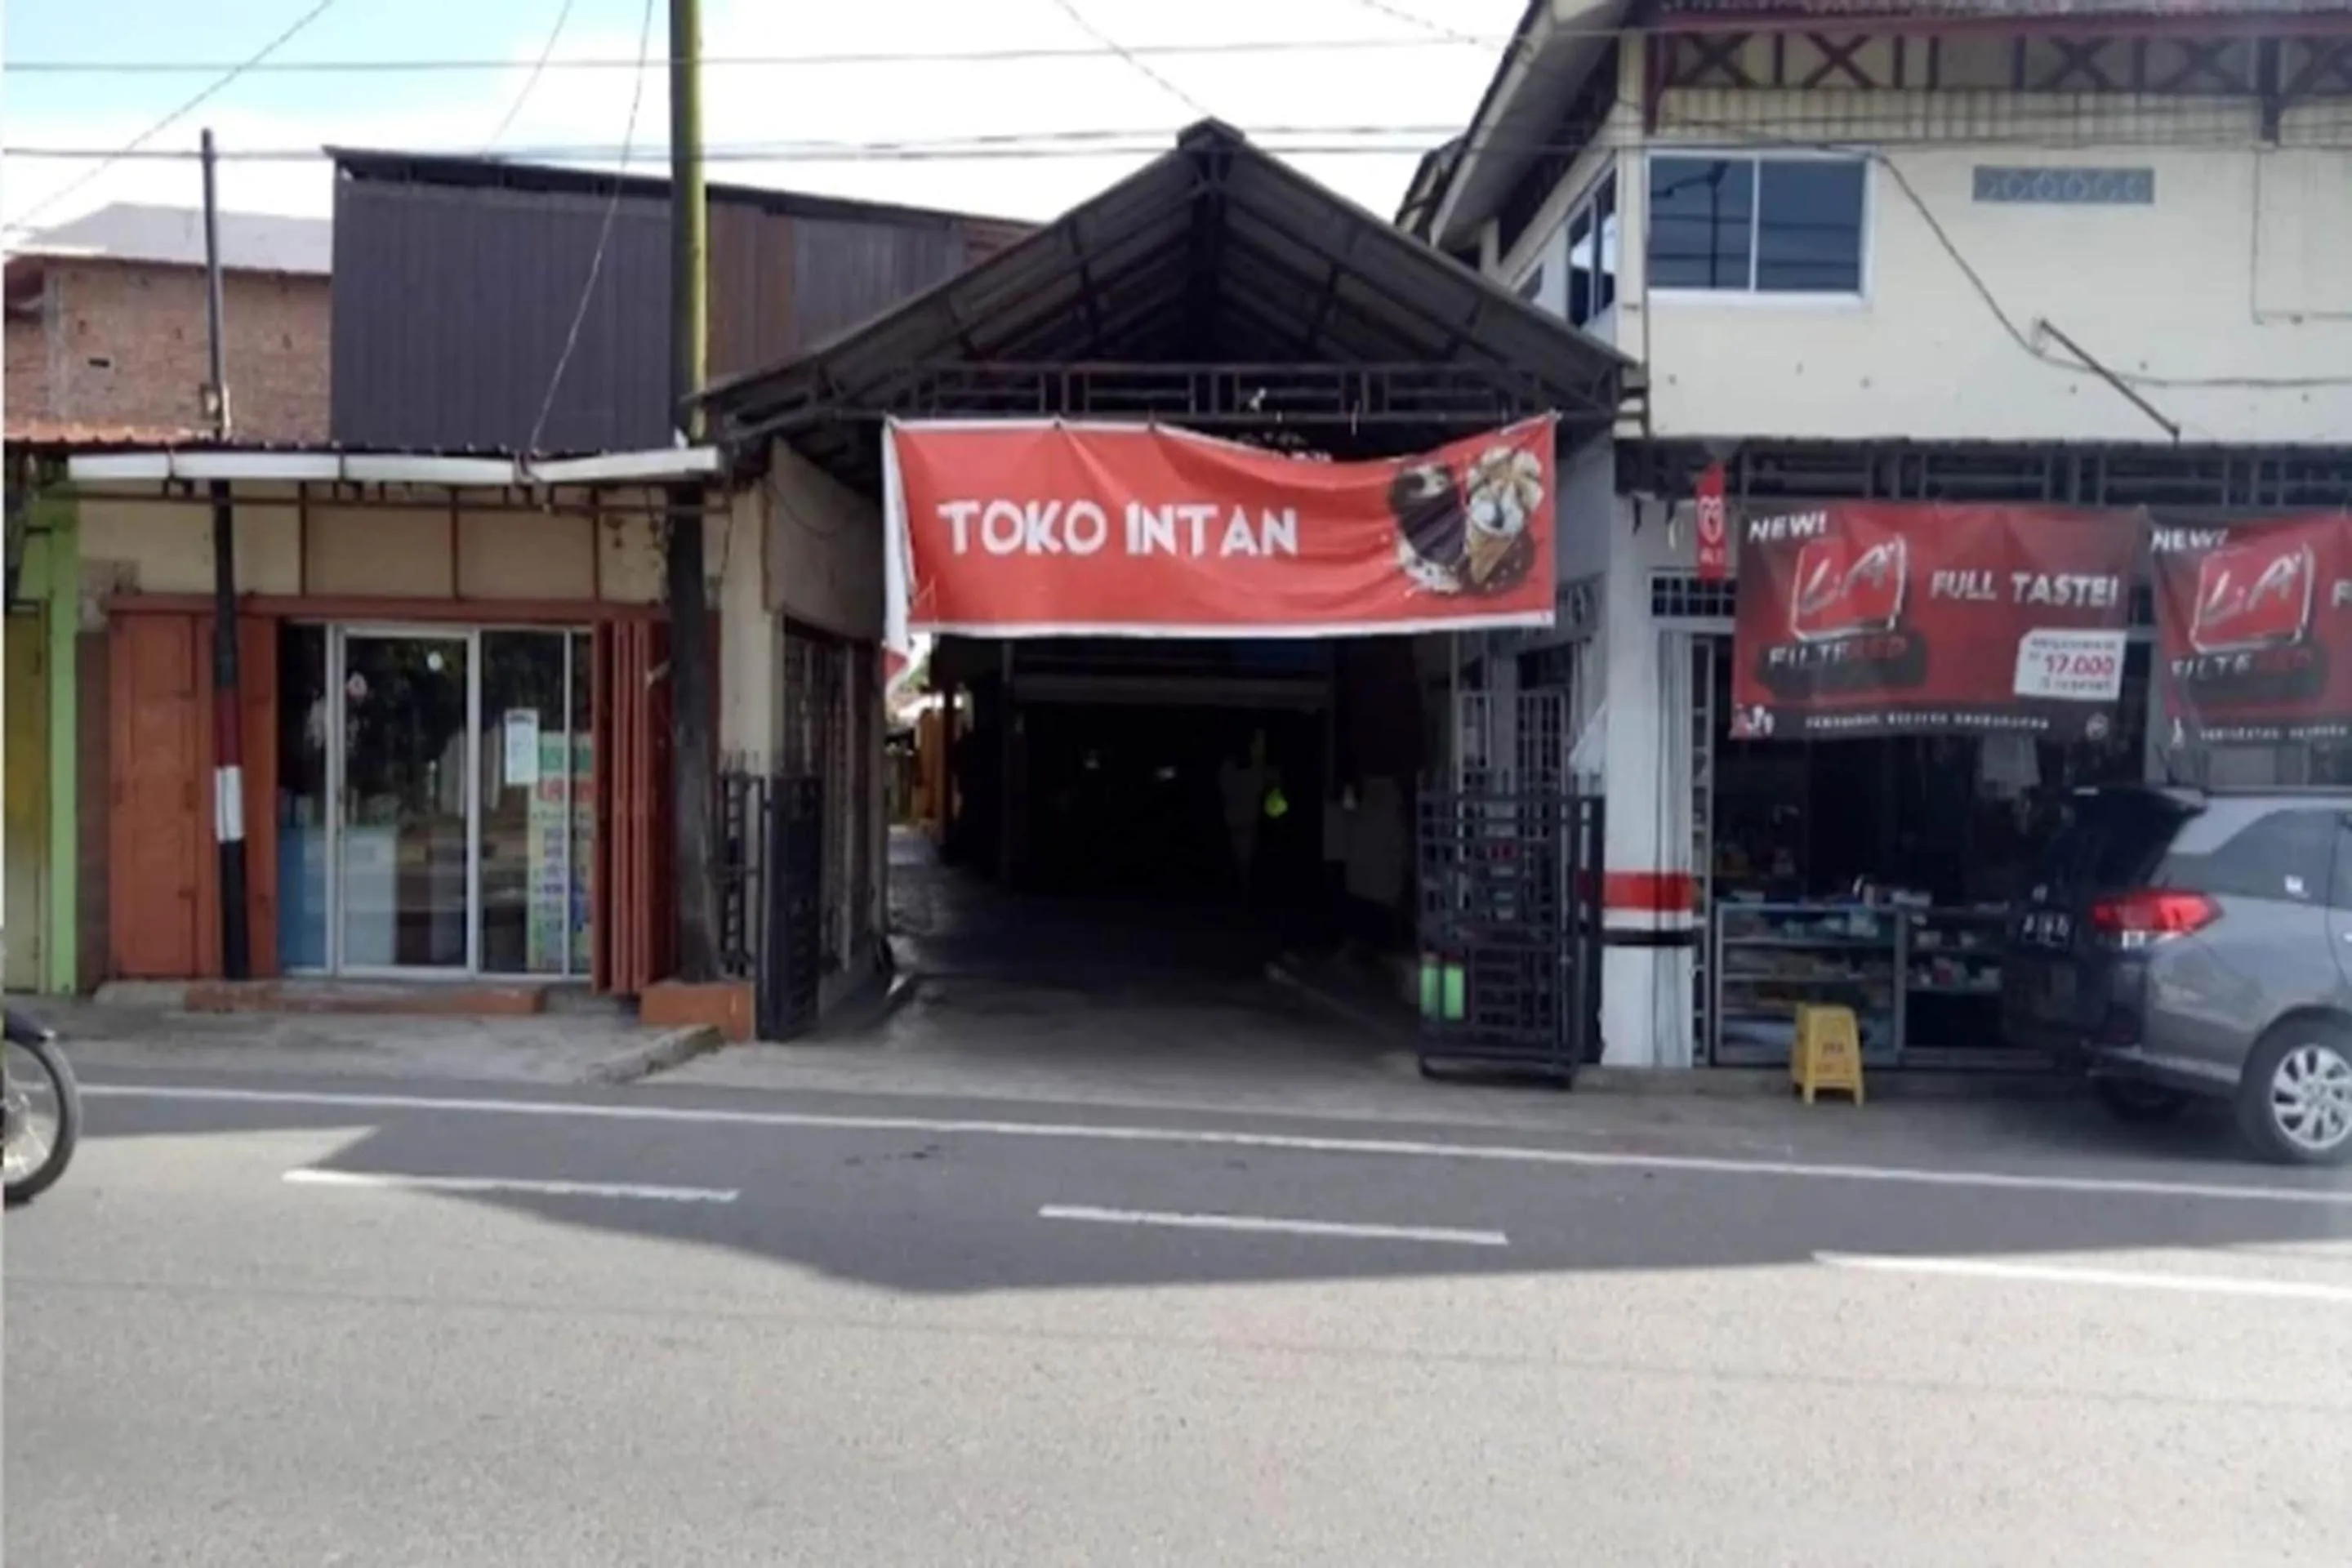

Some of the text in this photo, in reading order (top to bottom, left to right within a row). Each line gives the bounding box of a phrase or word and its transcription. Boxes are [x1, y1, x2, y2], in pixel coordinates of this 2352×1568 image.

[937, 499, 1298, 558] TOKO INTAN
[1747, 511, 1827, 542] NEW!
[1930, 570, 2120, 608] FULL TASTE!
[2044, 653, 2115, 675] 17.000
